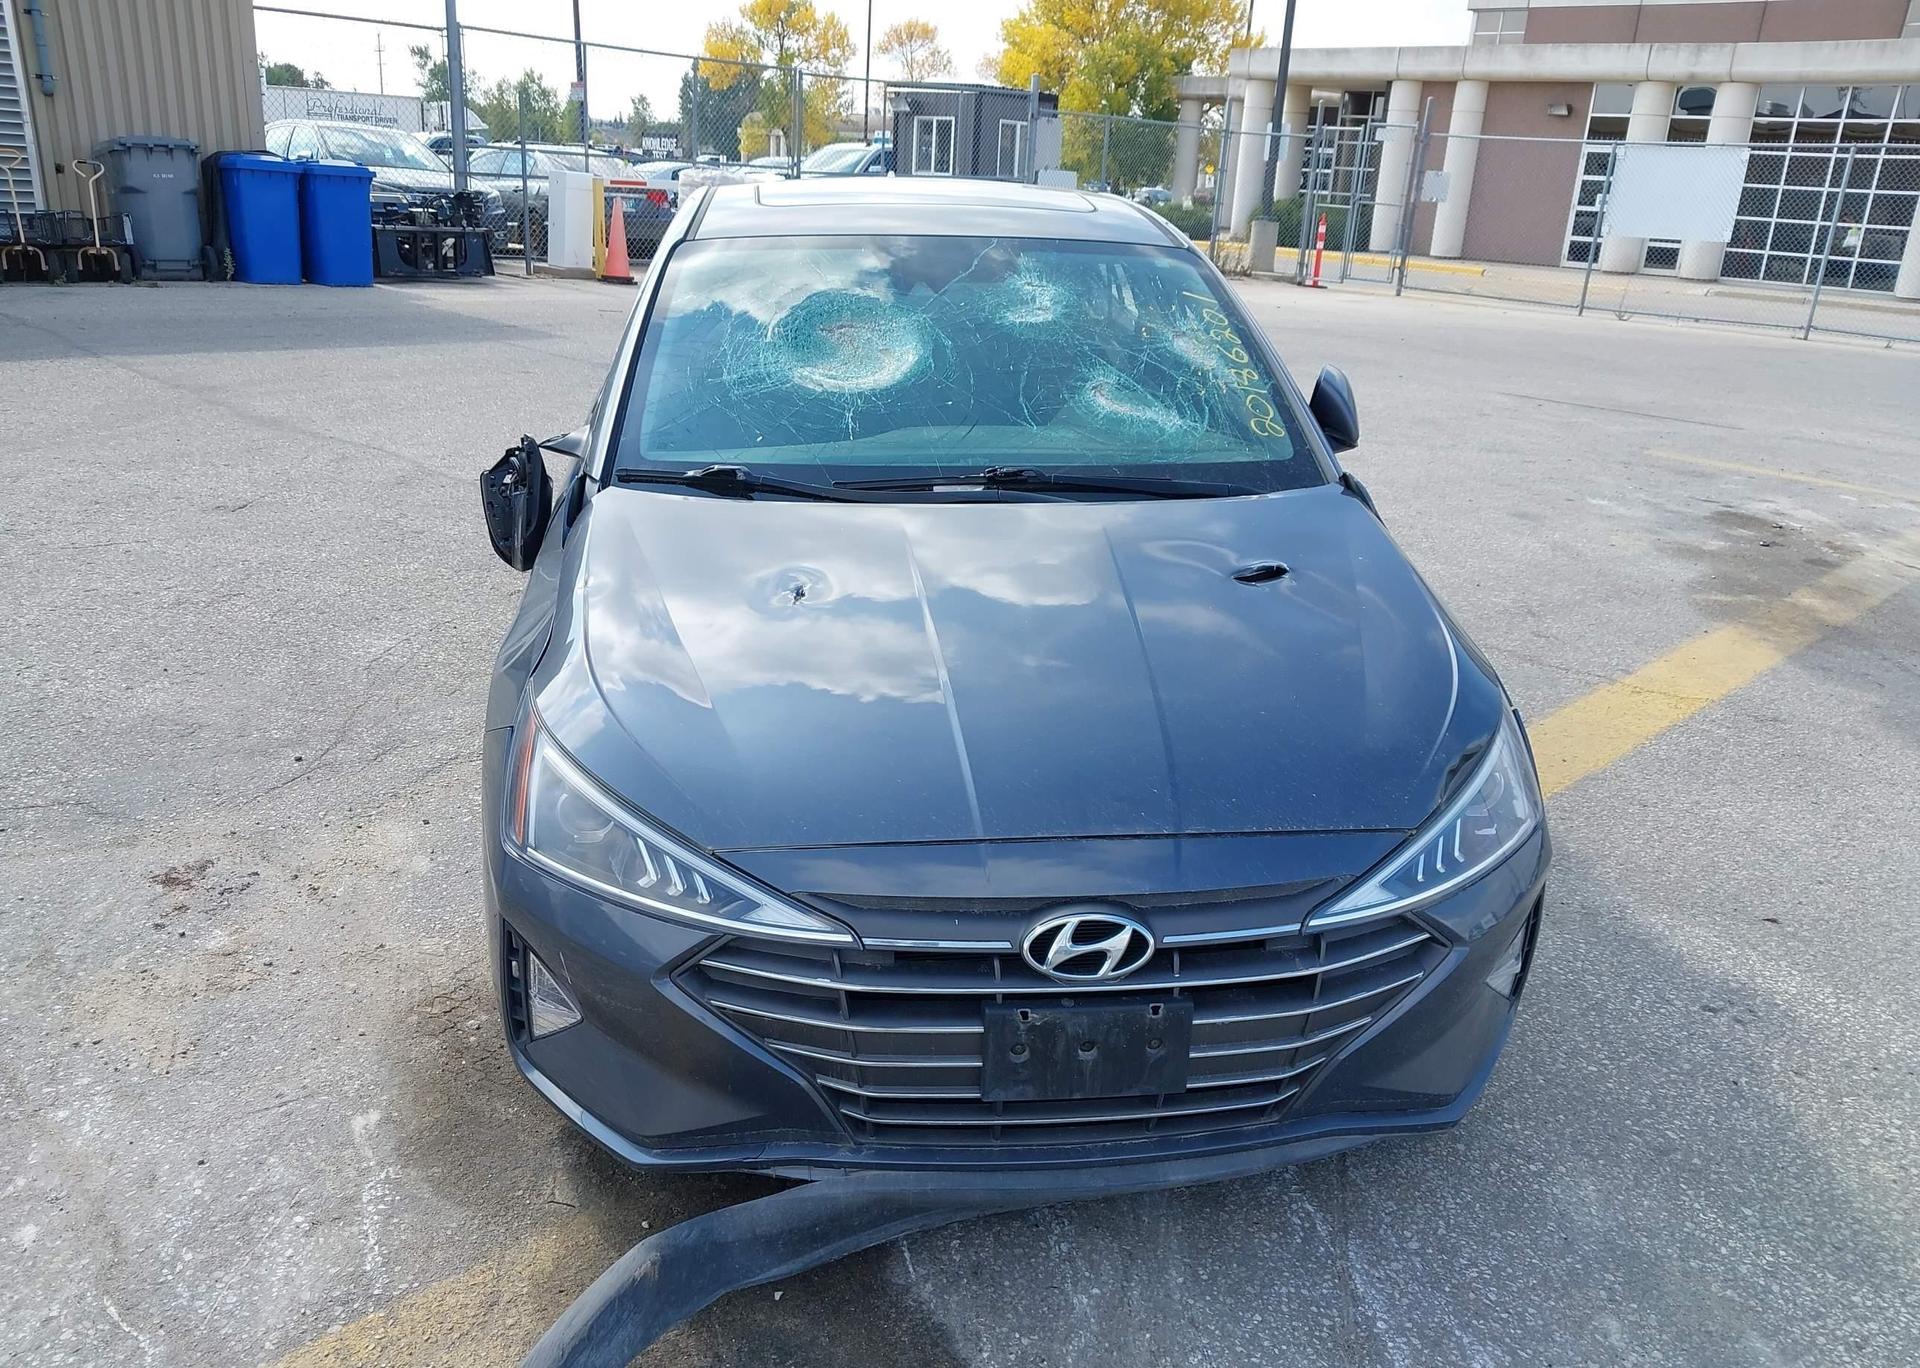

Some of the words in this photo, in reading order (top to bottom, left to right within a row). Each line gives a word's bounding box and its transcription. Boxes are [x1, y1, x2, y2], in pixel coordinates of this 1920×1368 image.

[336, 113, 374, 123] TRANSPORT
[375, 116, 398, 124] DRIVER
[642, 136, 677, 151] KNOWLEDGE
[652, 150, 668, 160] TEST
